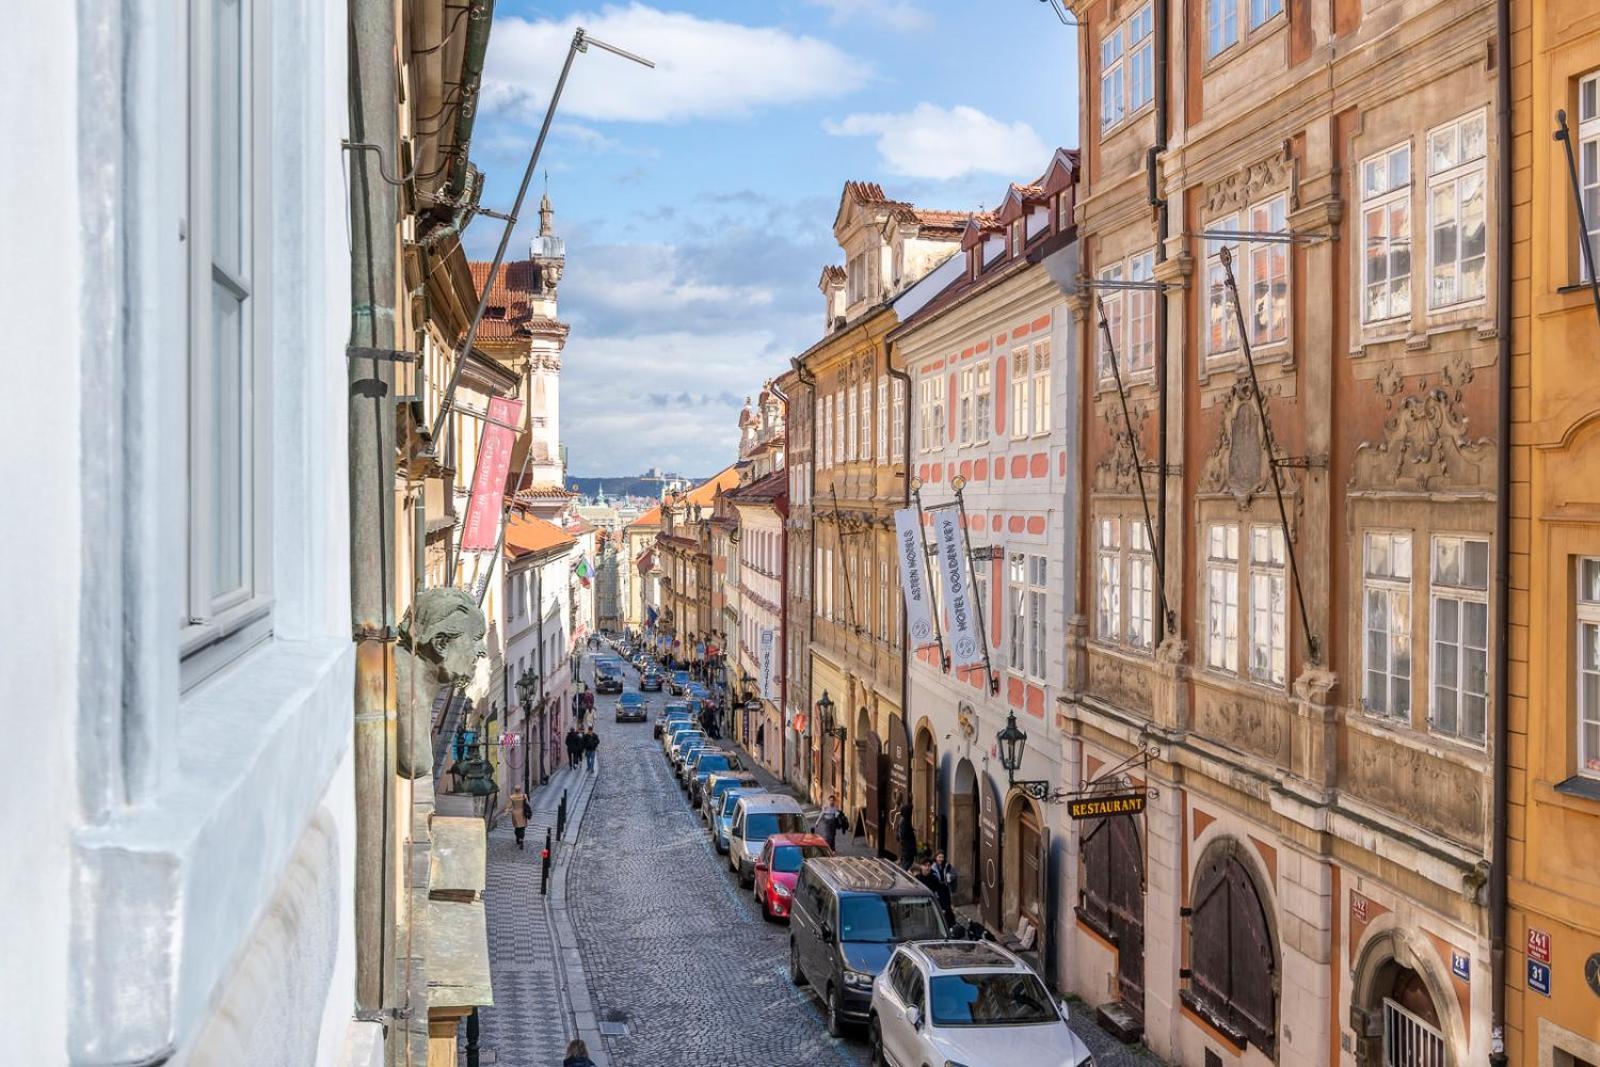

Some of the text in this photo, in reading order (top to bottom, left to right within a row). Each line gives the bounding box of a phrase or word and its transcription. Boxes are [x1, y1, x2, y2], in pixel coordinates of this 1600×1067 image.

[904, 529, 922, 601] ASTEN HOTELS
[943, 520, 967, 632] HOTEL GOLDEN KEY
[1072, 798, 1142, 816] RESTAURANT
[1530, 930, 1546, 948] 241
[1532, 966, 1542, 981] 31
